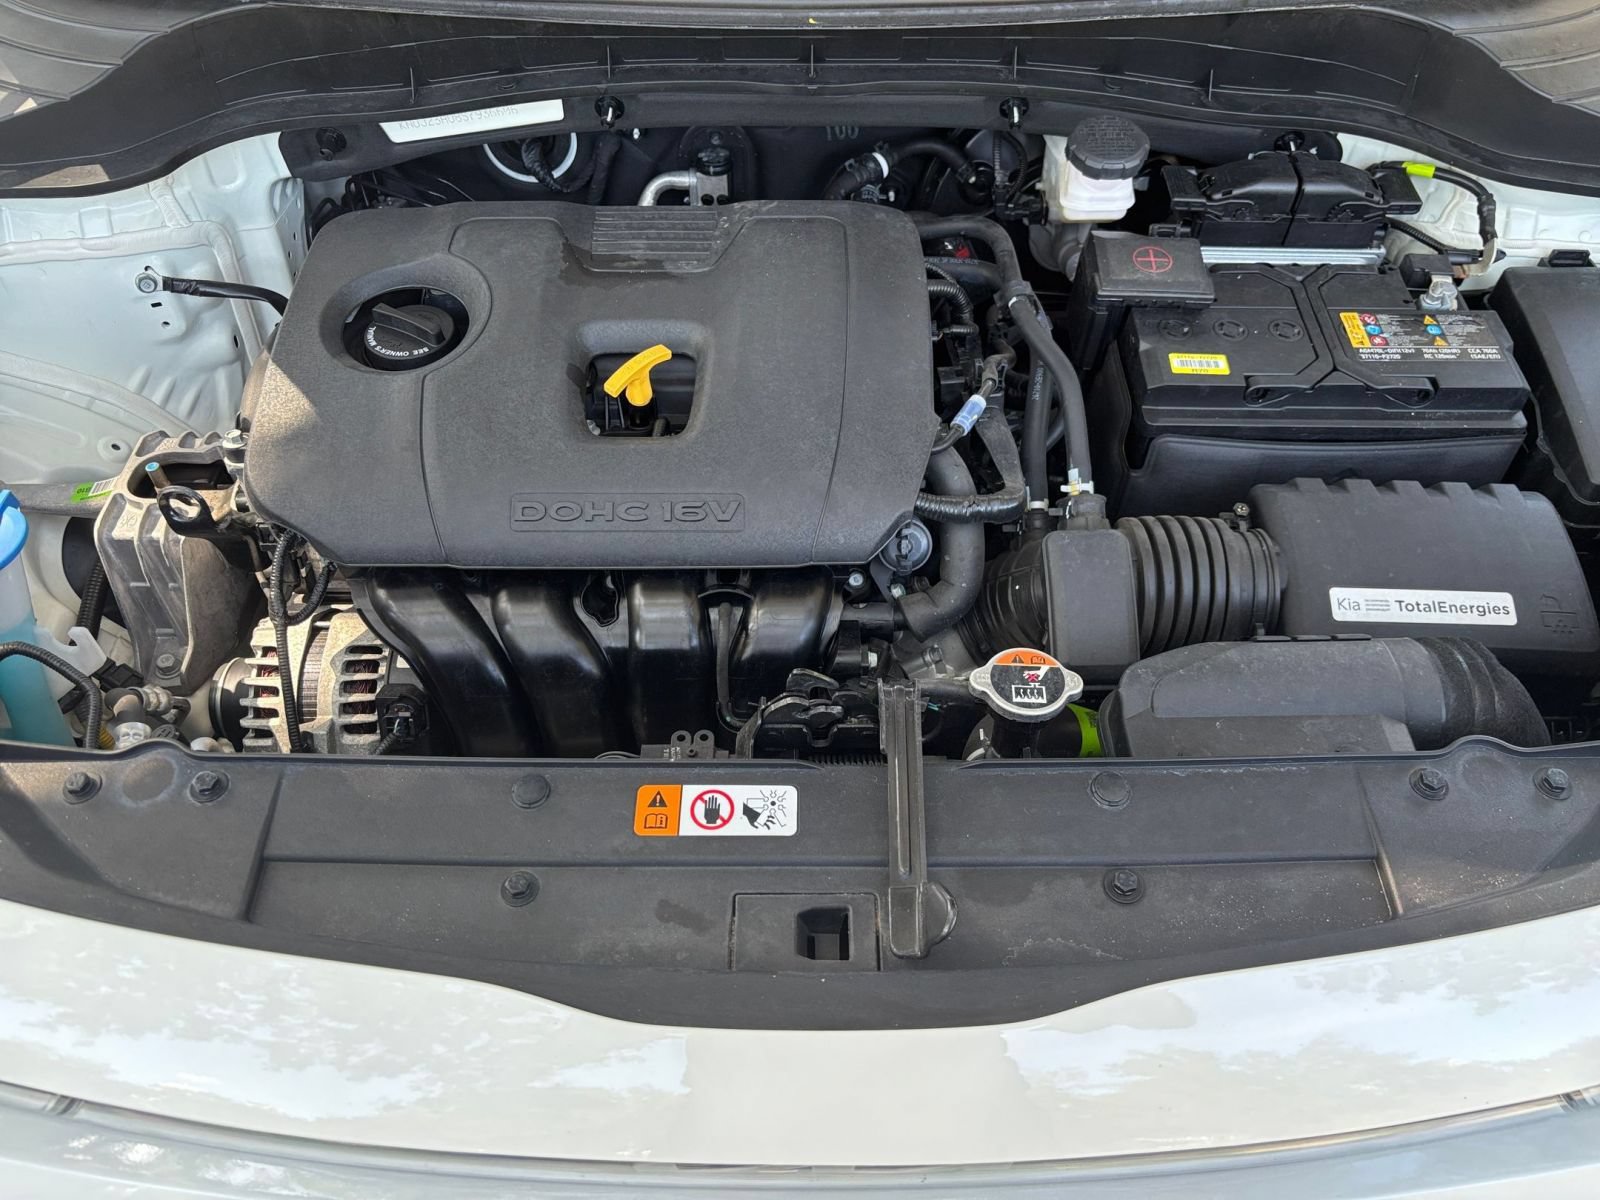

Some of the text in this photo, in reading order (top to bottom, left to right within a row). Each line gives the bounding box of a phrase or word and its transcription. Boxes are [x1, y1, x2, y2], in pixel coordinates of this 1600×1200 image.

[374, 345, 410, 357] OWNER'S
[412, 346, 430, 355] SEE
[514, 501, 741, 522] DOHC 16V
[1336, 597, 1510, 617] Kia TotalEnergies
